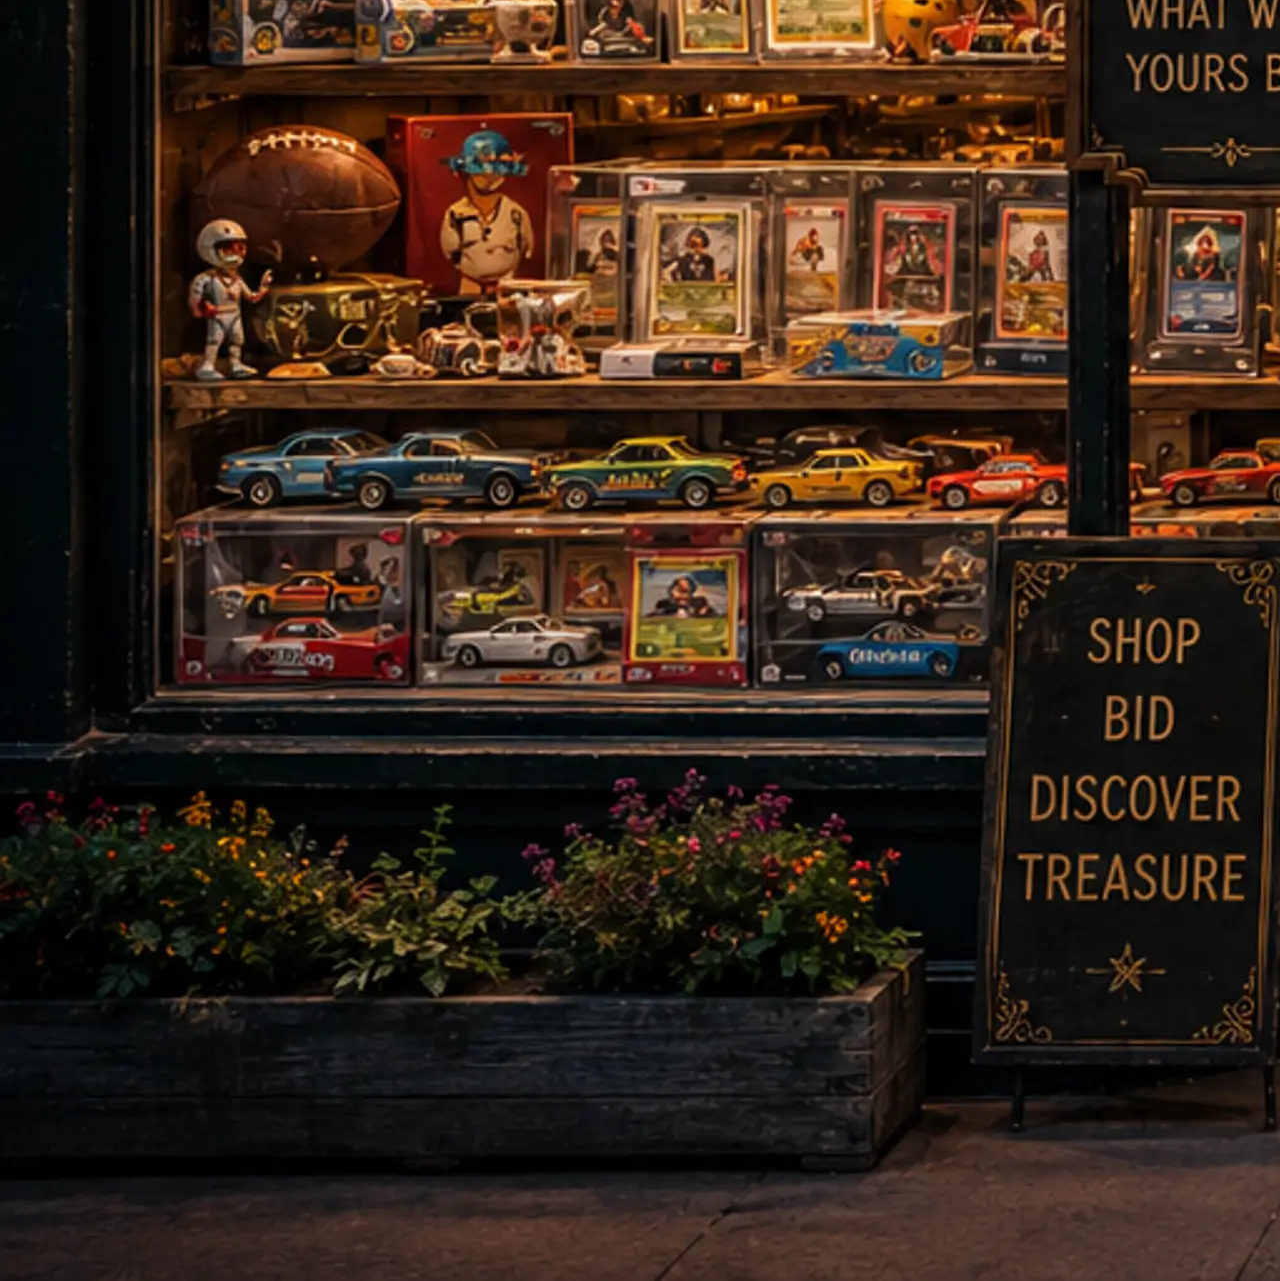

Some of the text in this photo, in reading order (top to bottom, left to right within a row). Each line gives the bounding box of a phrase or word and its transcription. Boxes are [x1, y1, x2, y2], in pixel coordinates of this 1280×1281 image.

[1125, 53, 1249, 91] YOURS
[1087, 617, 1201, 663] SHOP
[1104, 695, 1175, 740] BID
[1030, 774, 1241, 821] DISCOVER
[1017, 853, 1247, 901] TREASURE
